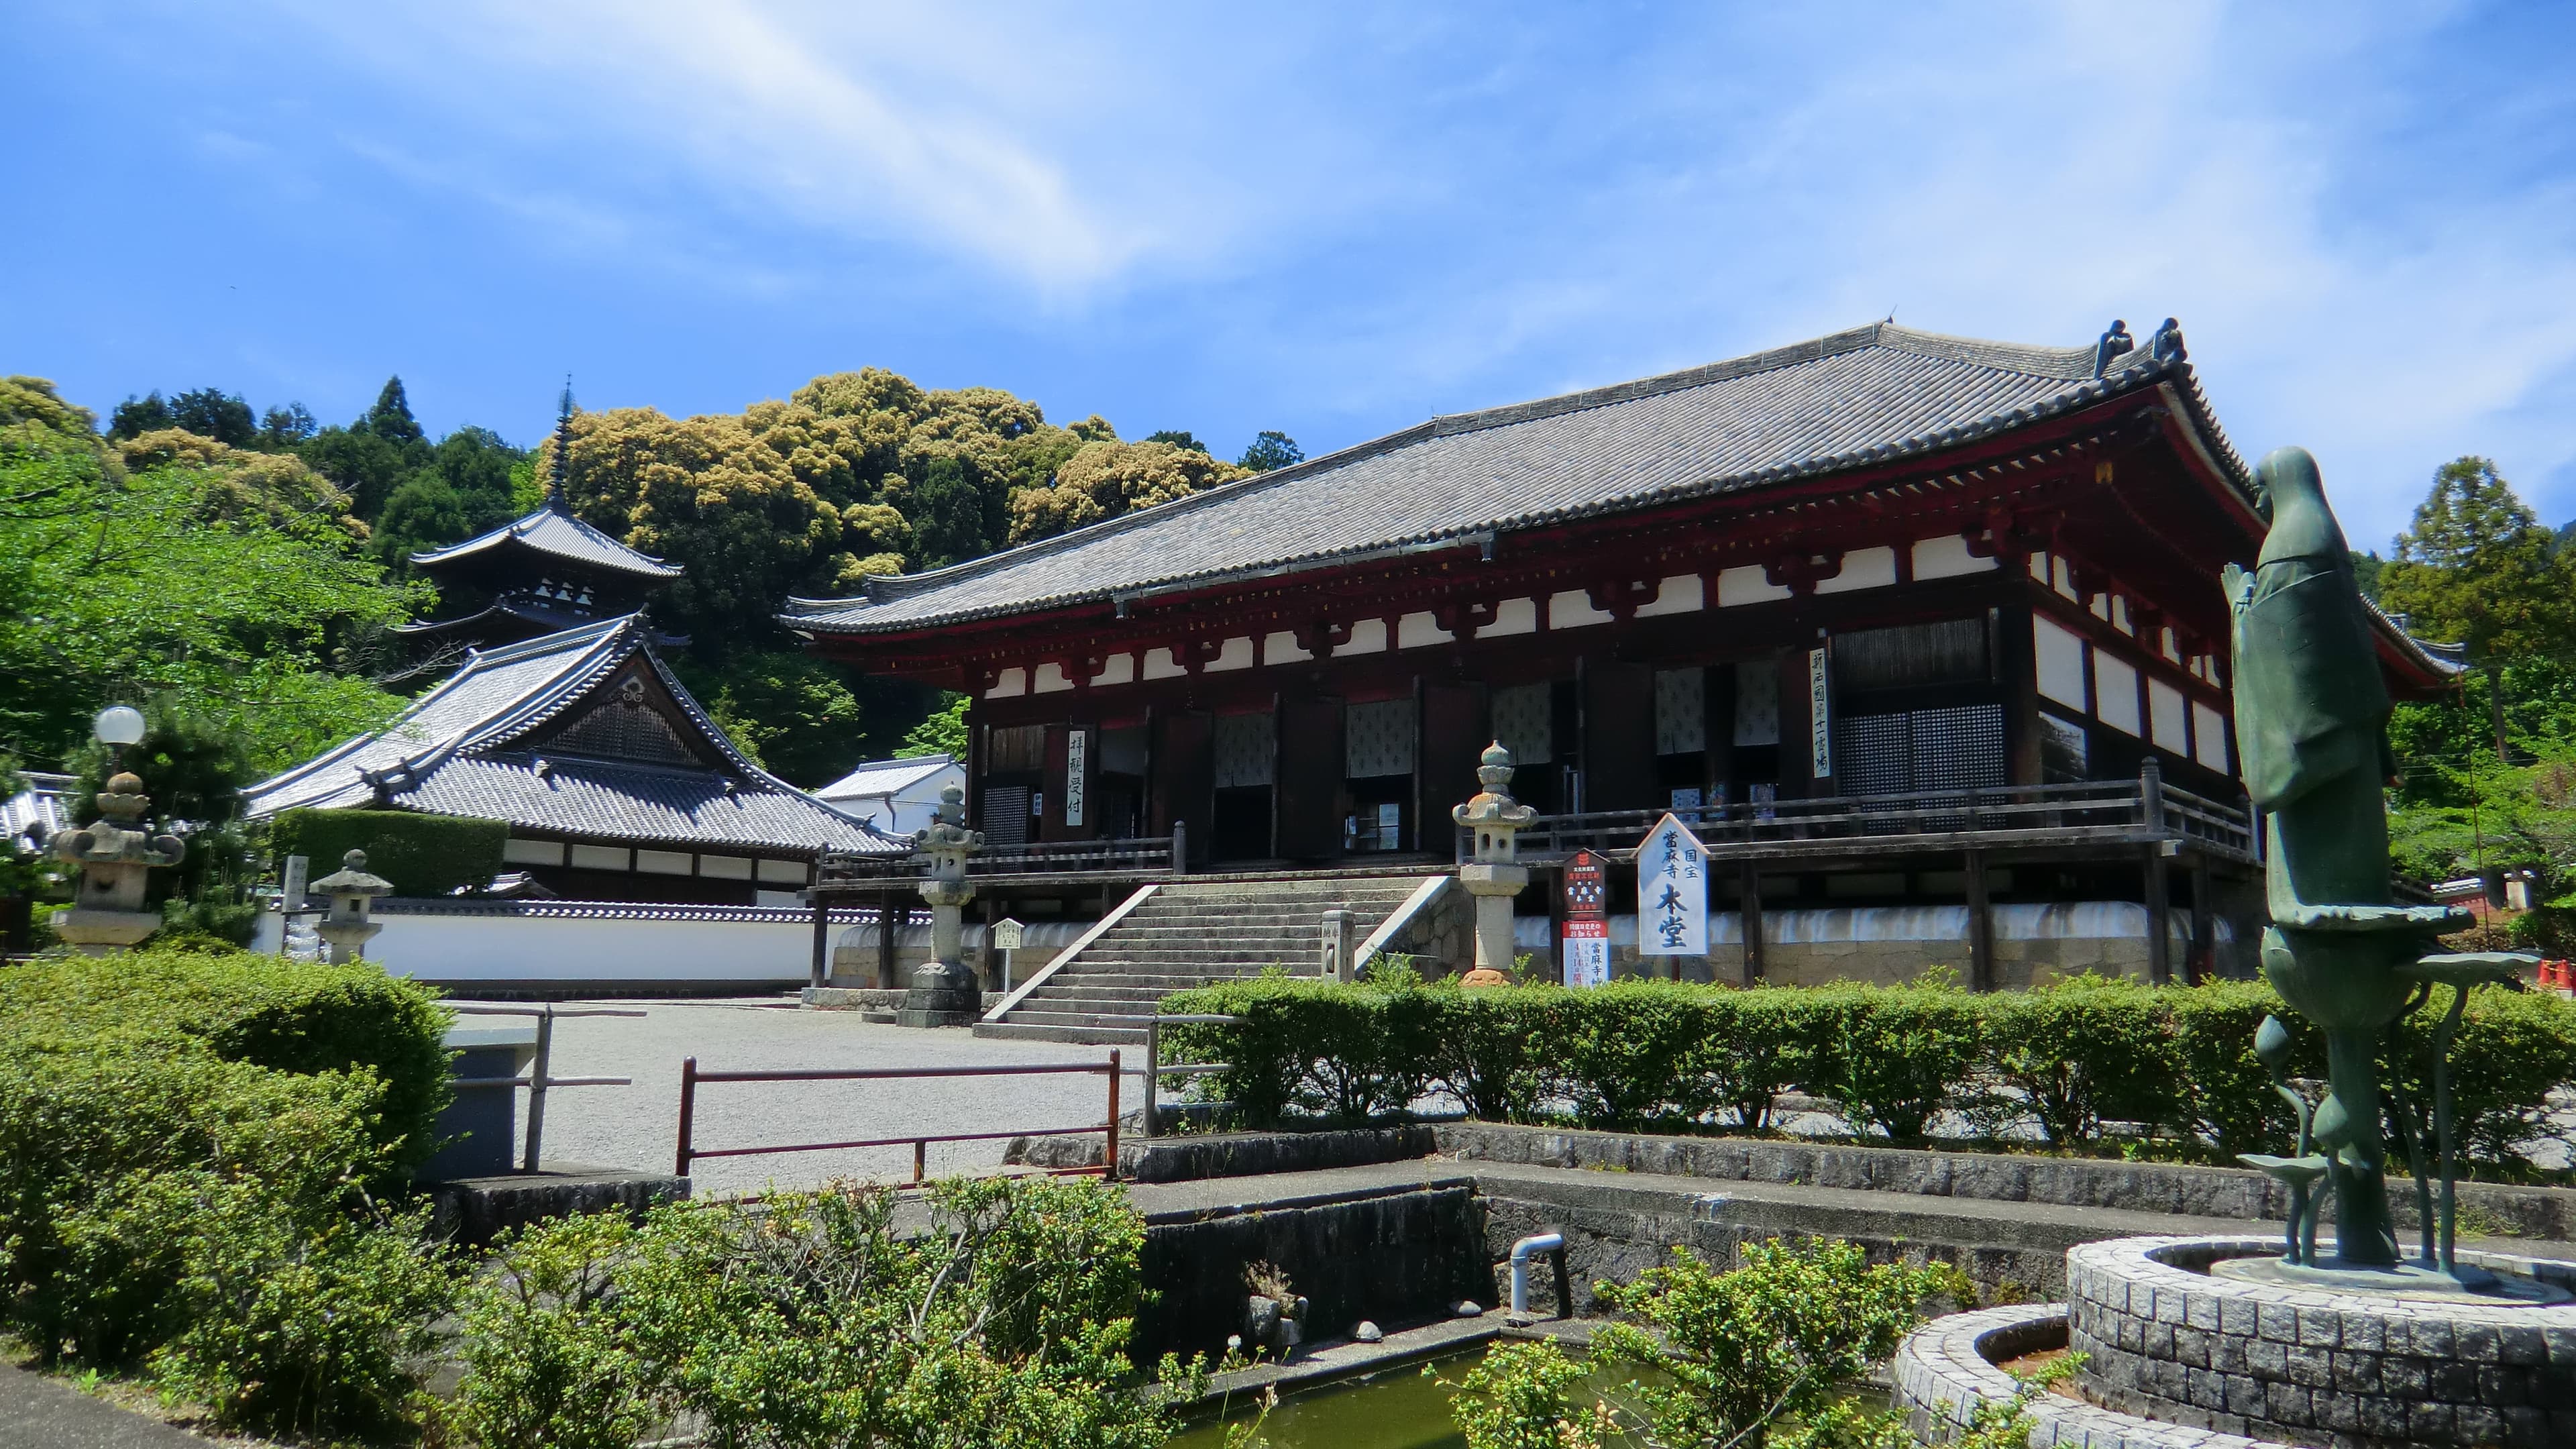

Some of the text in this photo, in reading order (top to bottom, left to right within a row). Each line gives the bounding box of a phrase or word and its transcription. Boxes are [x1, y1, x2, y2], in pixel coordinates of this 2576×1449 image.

[1656, 830, 1688, 948] 當麻寺 本堂
[1684, 849, 1698, 878] 国宝
